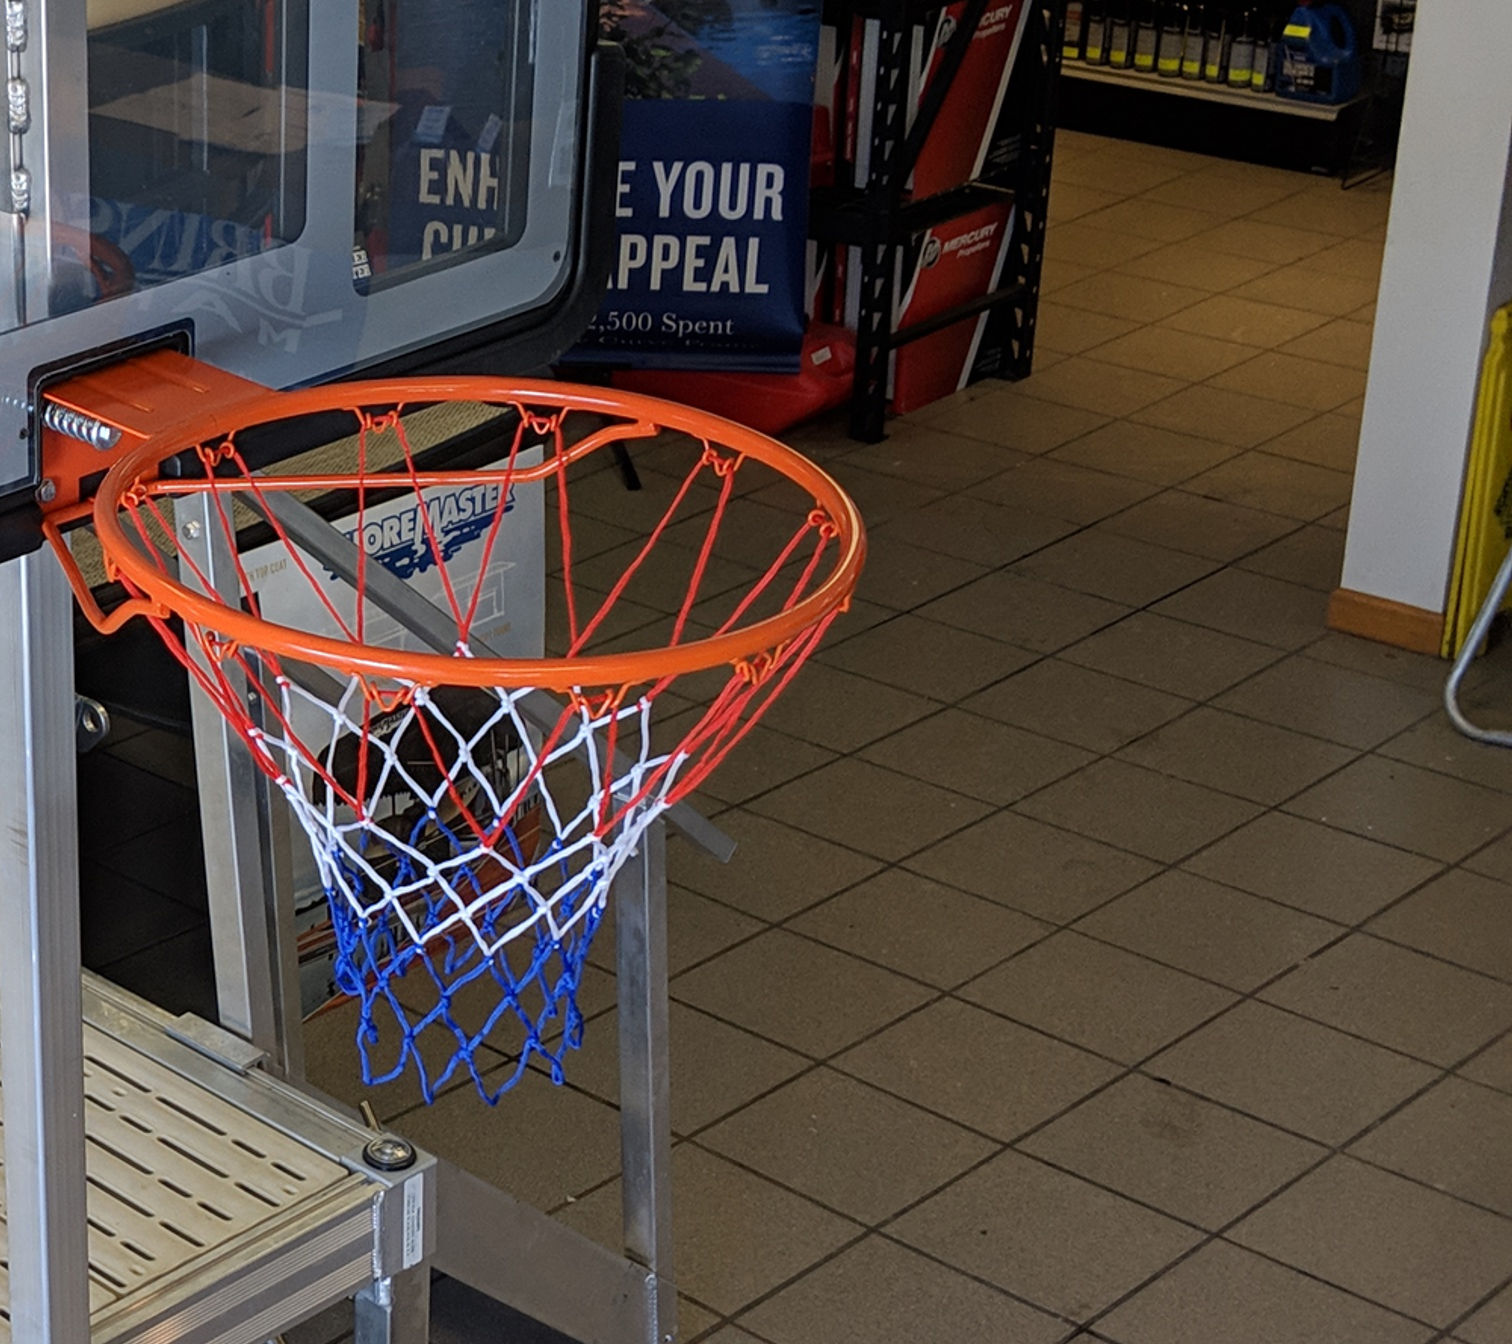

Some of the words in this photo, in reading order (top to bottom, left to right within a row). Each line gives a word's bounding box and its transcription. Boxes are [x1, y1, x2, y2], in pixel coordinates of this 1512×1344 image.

[652, 160, 786, 221] YOUR
[942, 222, 999, 254] MERCURY
[606, 234, 769, 294] PPEAL
[661, 312, 735, 337] Spent
